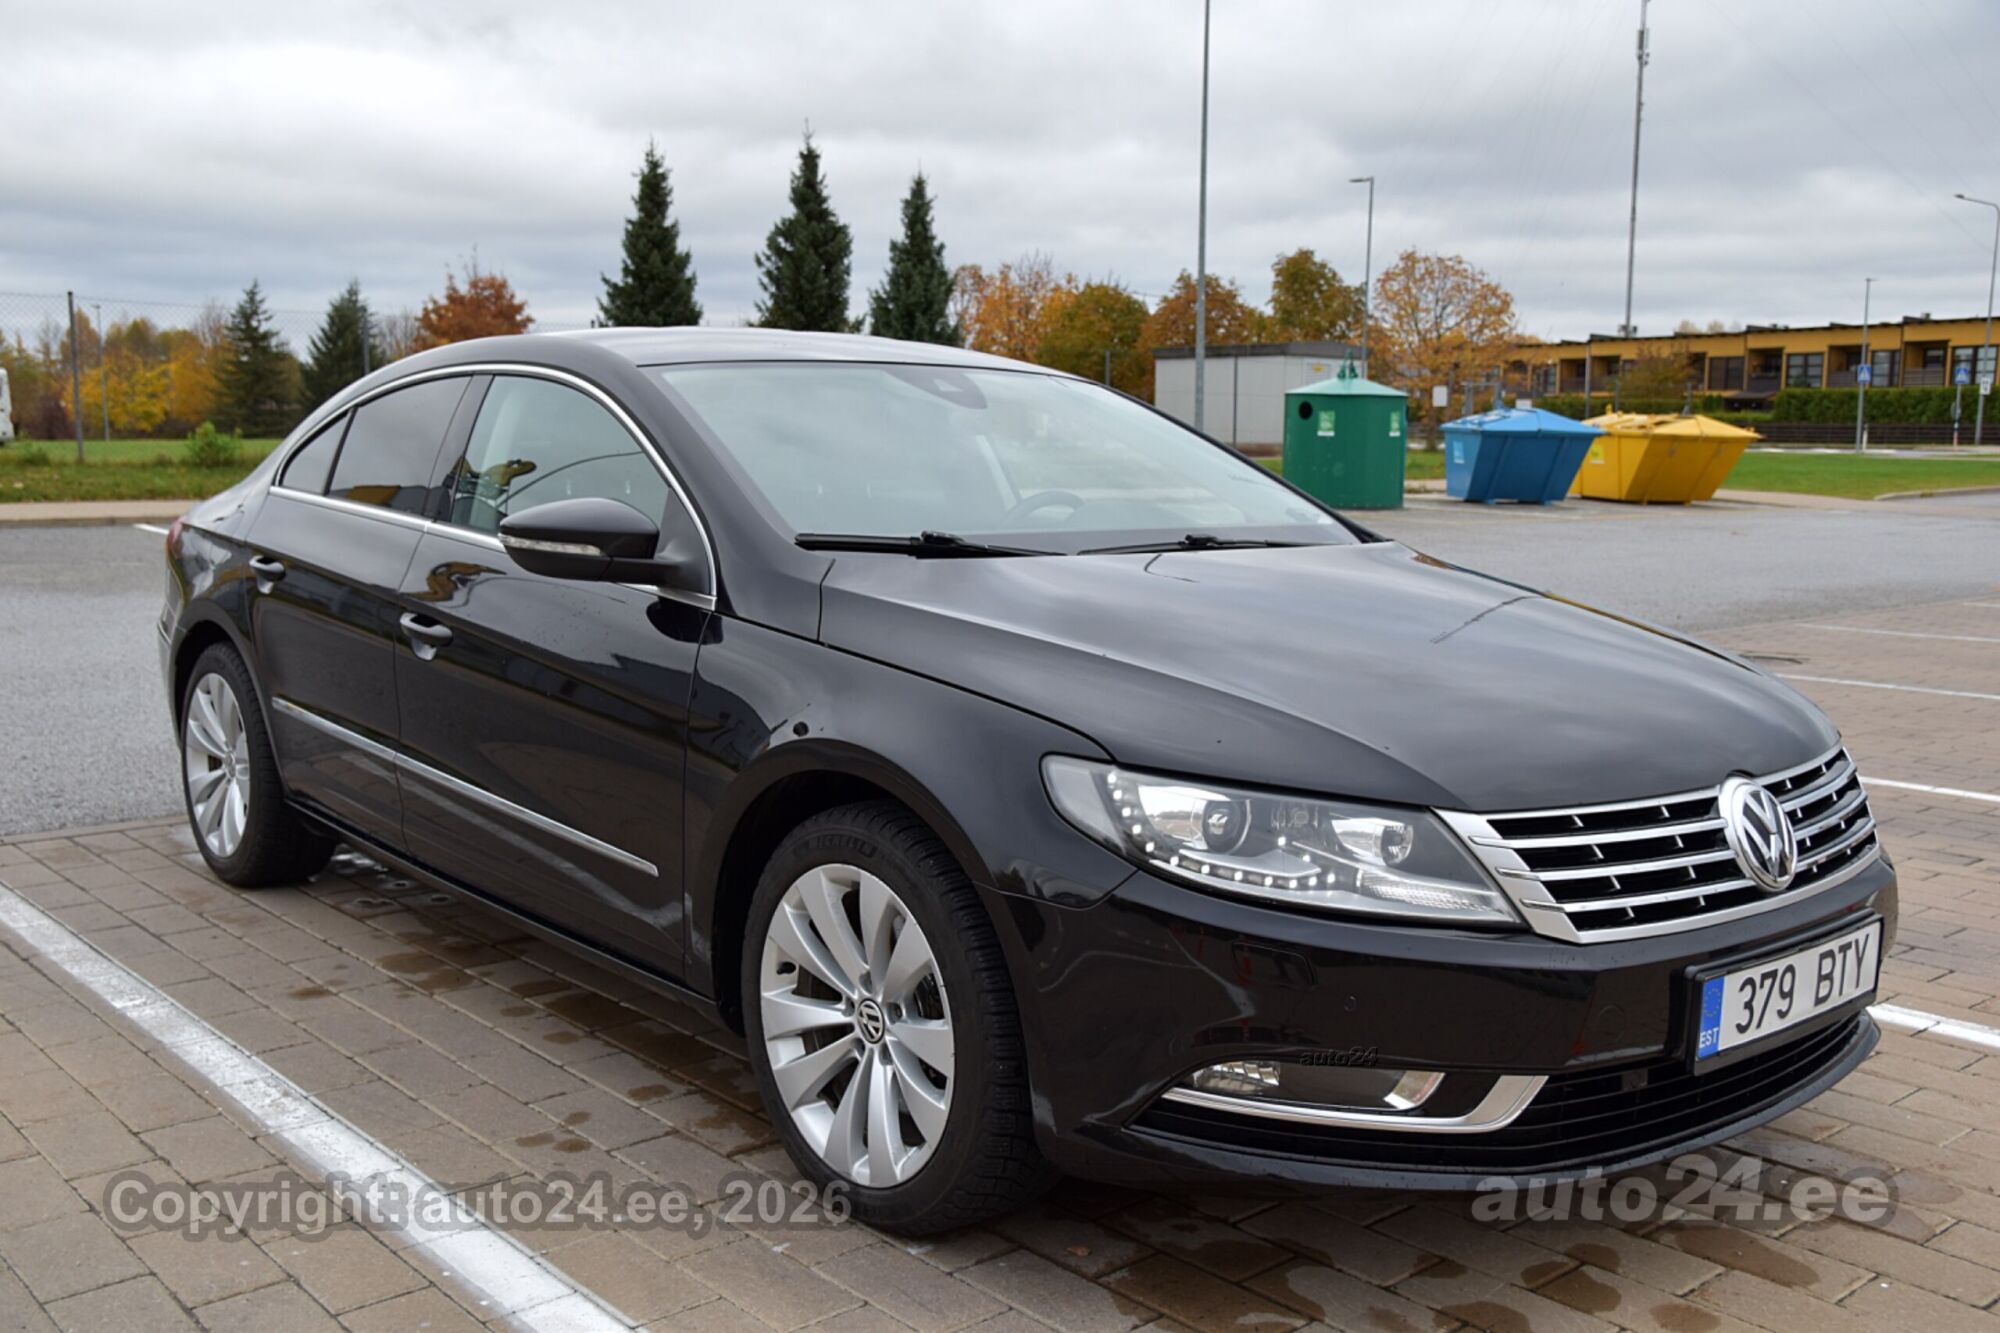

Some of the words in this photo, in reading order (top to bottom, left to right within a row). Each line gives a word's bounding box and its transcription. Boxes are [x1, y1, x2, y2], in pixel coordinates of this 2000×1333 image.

[1730, 782, 1796, 890] VW
[1735, 964, 1796, 1034] 379
[1814, 934, 1869, 1007] BTY
[1700, 1027, 1720, 1048] EST
